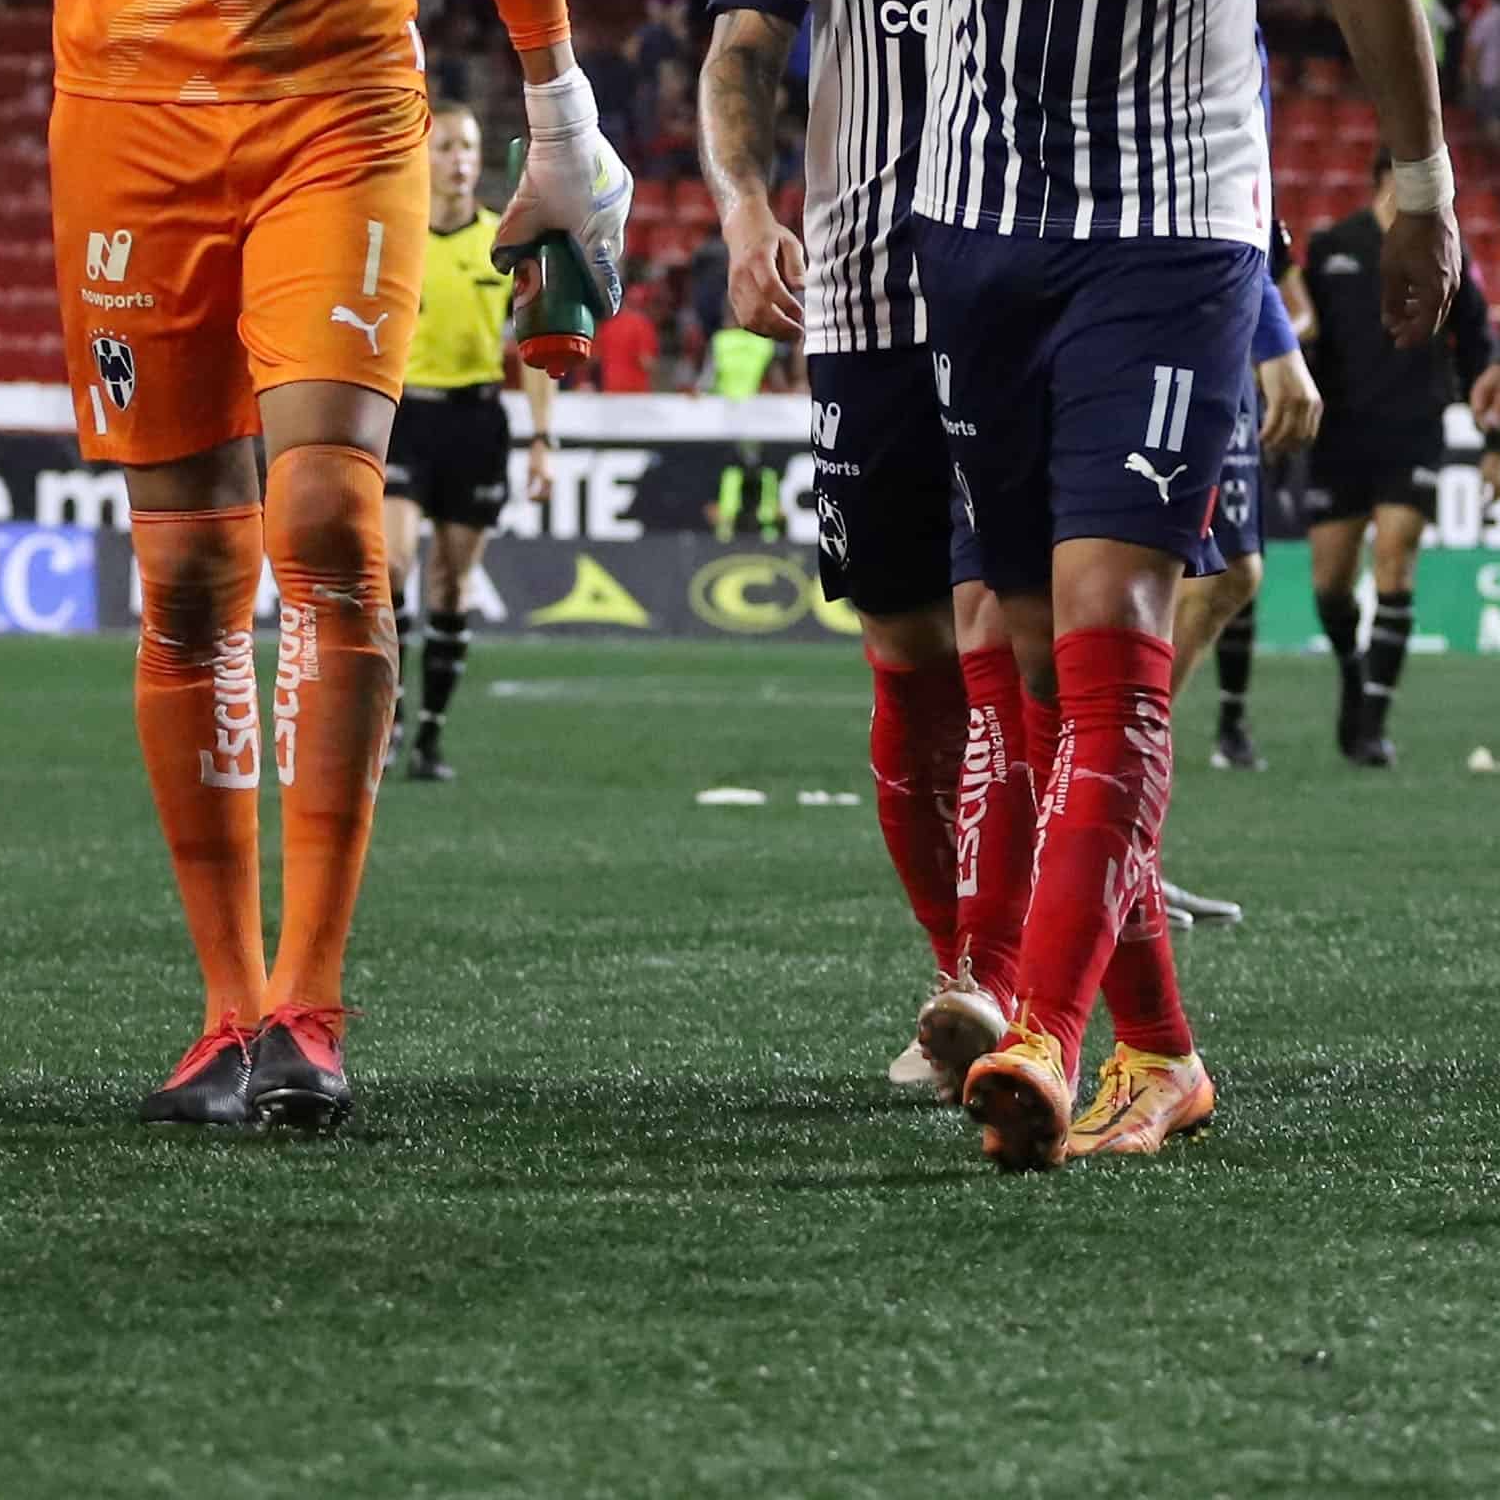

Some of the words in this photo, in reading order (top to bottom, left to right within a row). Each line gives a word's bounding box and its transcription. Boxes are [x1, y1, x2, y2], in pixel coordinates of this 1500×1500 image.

[362, 219, 384, 296] 1
[81, 285, 155, 311] nowports
[1145, 365, 1195, 453] 11
